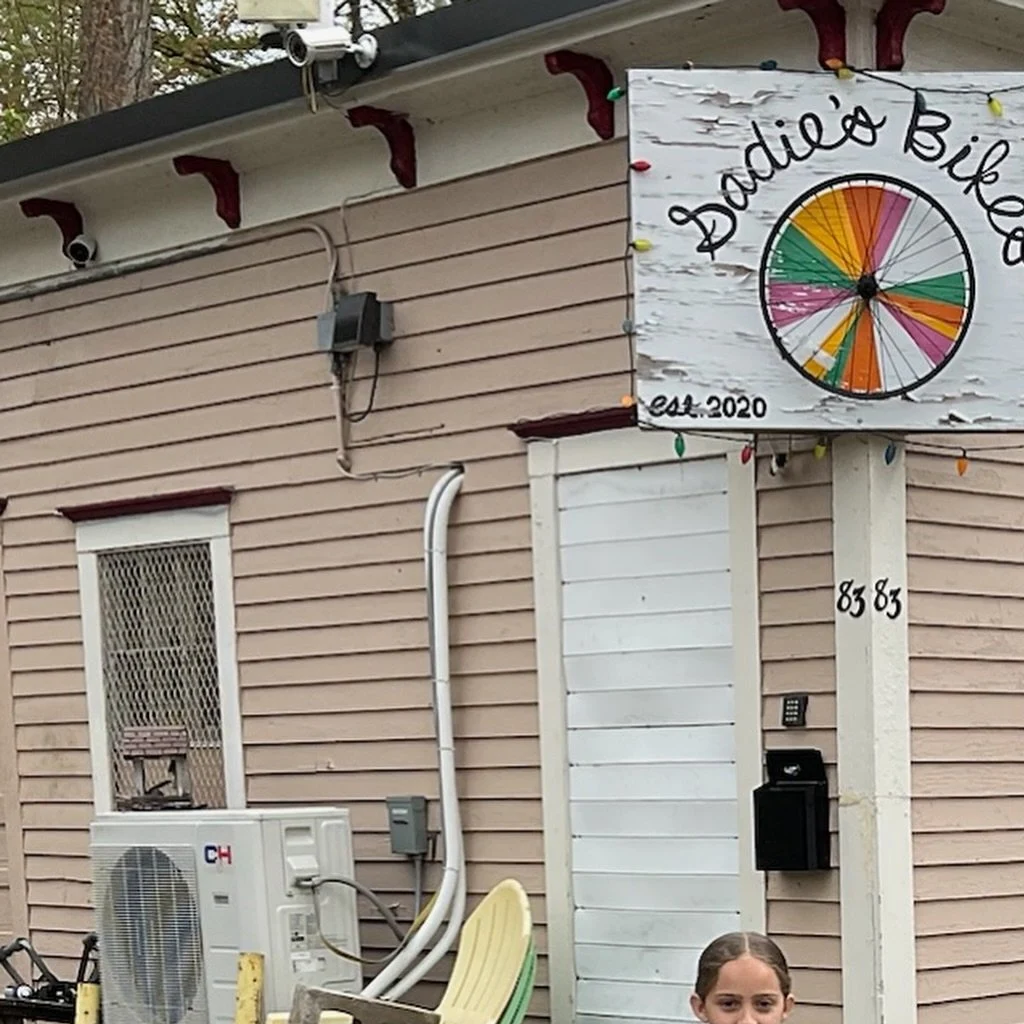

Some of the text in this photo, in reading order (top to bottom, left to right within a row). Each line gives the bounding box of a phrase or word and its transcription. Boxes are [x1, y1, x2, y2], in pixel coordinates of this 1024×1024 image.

[668, 95, 886, 261] Sadie's
[706, 395, 767, 418] 2020
[837, 578, 866, 618] 83
[874, 577, 902, 620] 83
[204, 845, 232, 865] CH
